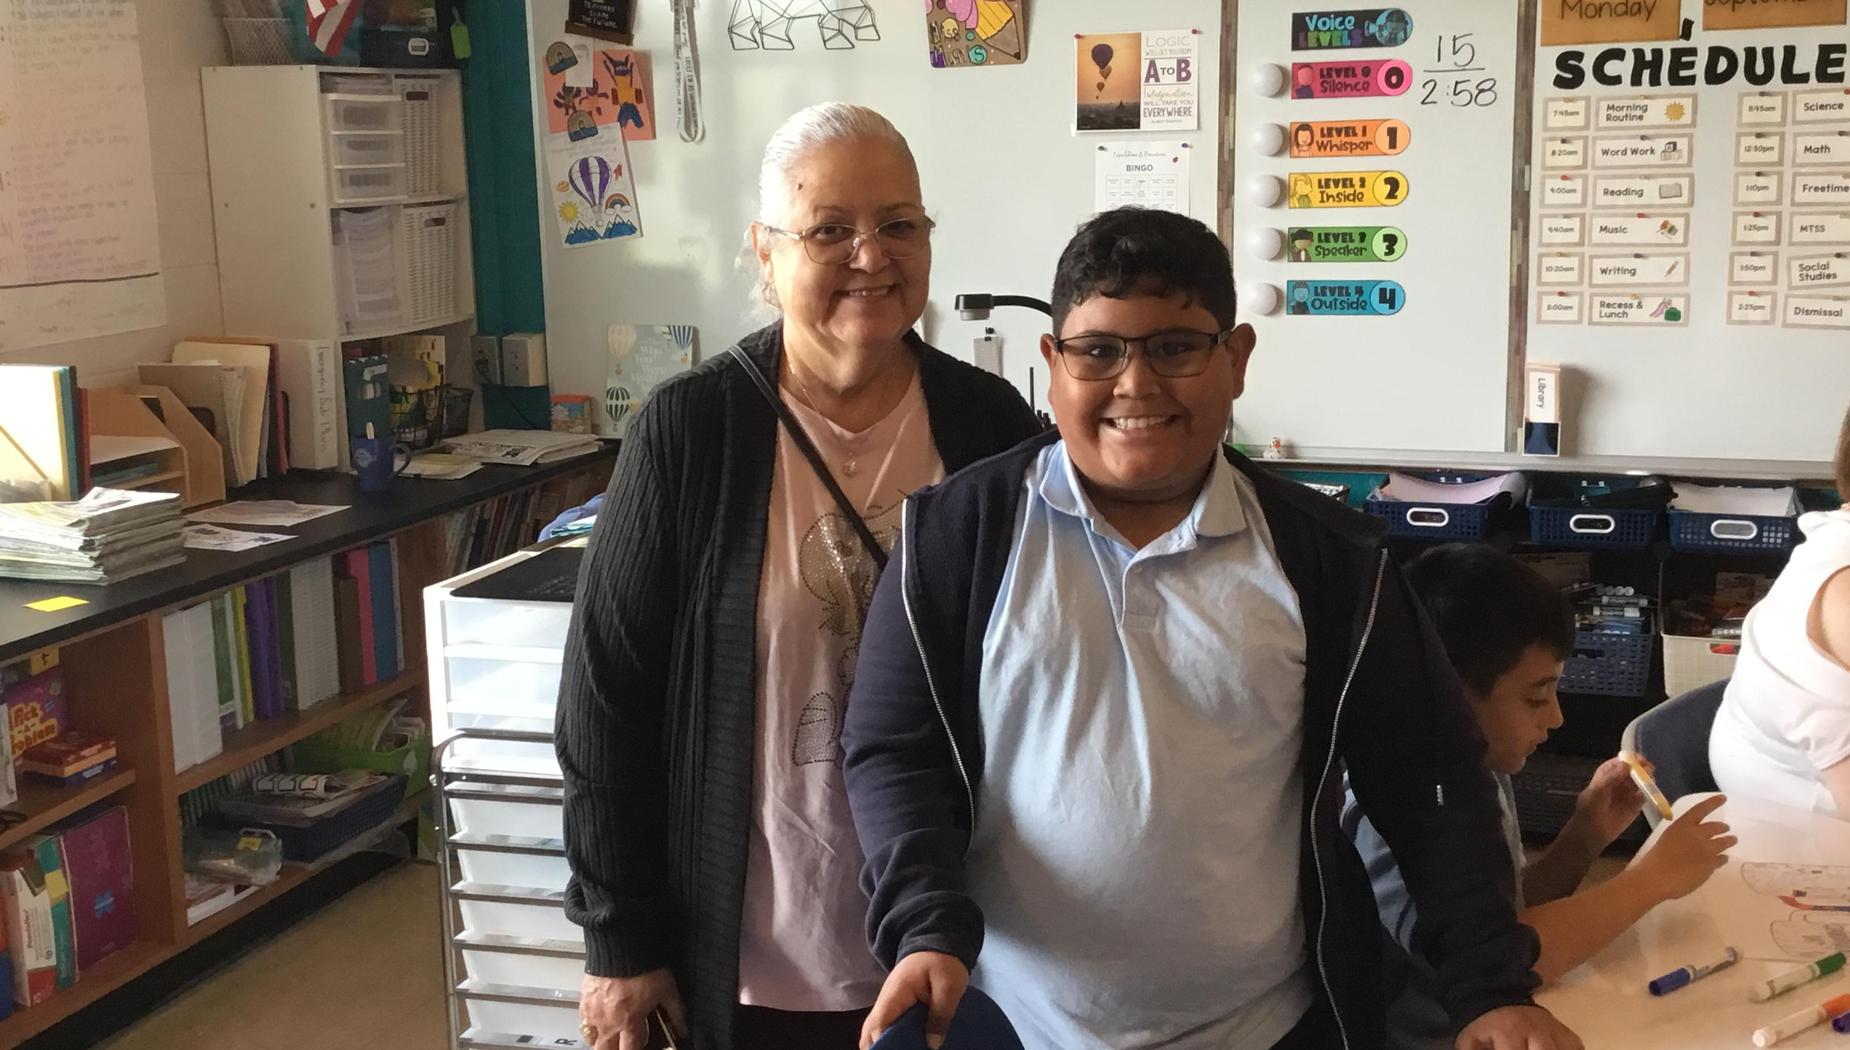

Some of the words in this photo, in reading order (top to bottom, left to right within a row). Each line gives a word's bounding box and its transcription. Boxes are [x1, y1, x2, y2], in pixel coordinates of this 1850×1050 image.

[1561, 0, 1657, 22] Monday
[1306, 15, 1355, 31] Voice
[1145, 36, 1192, 48] LOGIC
[1299, 30, 1363, 48] LEVELS
[1436, 33, 1475, 68] 15
[1144, 59, 1160, 83] A
[1160, 67, 1175, 76] TO
[1176, 58, 1192, 82] B
[1320, 67, 1357, 79] LEVEL
[1552, 43, 1847, 90] SCHEDULE
[1384, 66, 1404, 89] 0
[1320, 79, 1370, 93] Silence
[1420, 78, 1498, 107] 2:58
[1143, 106, 1192, 118] EVERYWHERE
[1606, 103, 1648, 114] Morning
[1803, 102, 1844, 112] Science
[1606, 113, 1644, 122] Routine
[1320, 126, 1358, 139] LEVEL
[1386, 126, 1398, 150] 1
[1316, 138, 1373, 152] Whisper
[1601, 148, 1628, 157] Word
[1630, 146, 1656, 156] Work
[1803, 144, 1831, 154] Math
[1126, 164, 1154, 172] BINGO
[1317, 177, 1356, 190] LEVEL
[1383, 176, 1400, 200] 2
[1802, 183, 1850, 193] Freetime
[1319, 188, 1364, 204] Inside
[1603, 187, 1644, 198] Reading
[1599, 225, 1628, 234] Music
[1800, 224, 1826, 233] MTSS
[1317, 232, 1356, 244] LEVEL
[1314, 243, 1367, 260] Speaker
[1382, 233, 1398, 257] 3
[1599, 266, 1637, 277] Writing
[1798, 261, 1830, 272] Social
[1798, 272, 1837, 282] Studies
[1313, 285, 1353, 297] LEVEL
[1311, 296, 1368, 312] Outside
[1378, 287, 1396, 310] 4
[1599, 300, 1634, 310] Recess
[1635, 300, 1644, 310] &
[1599, 309, 1629, 319] Lunch
[1794, 306, 1843, 317] Dismissal
[1536, 377, 1547, 409] Library
[14, 706, 39, 726] Pick
[11, 724, 56, 754] roblem
